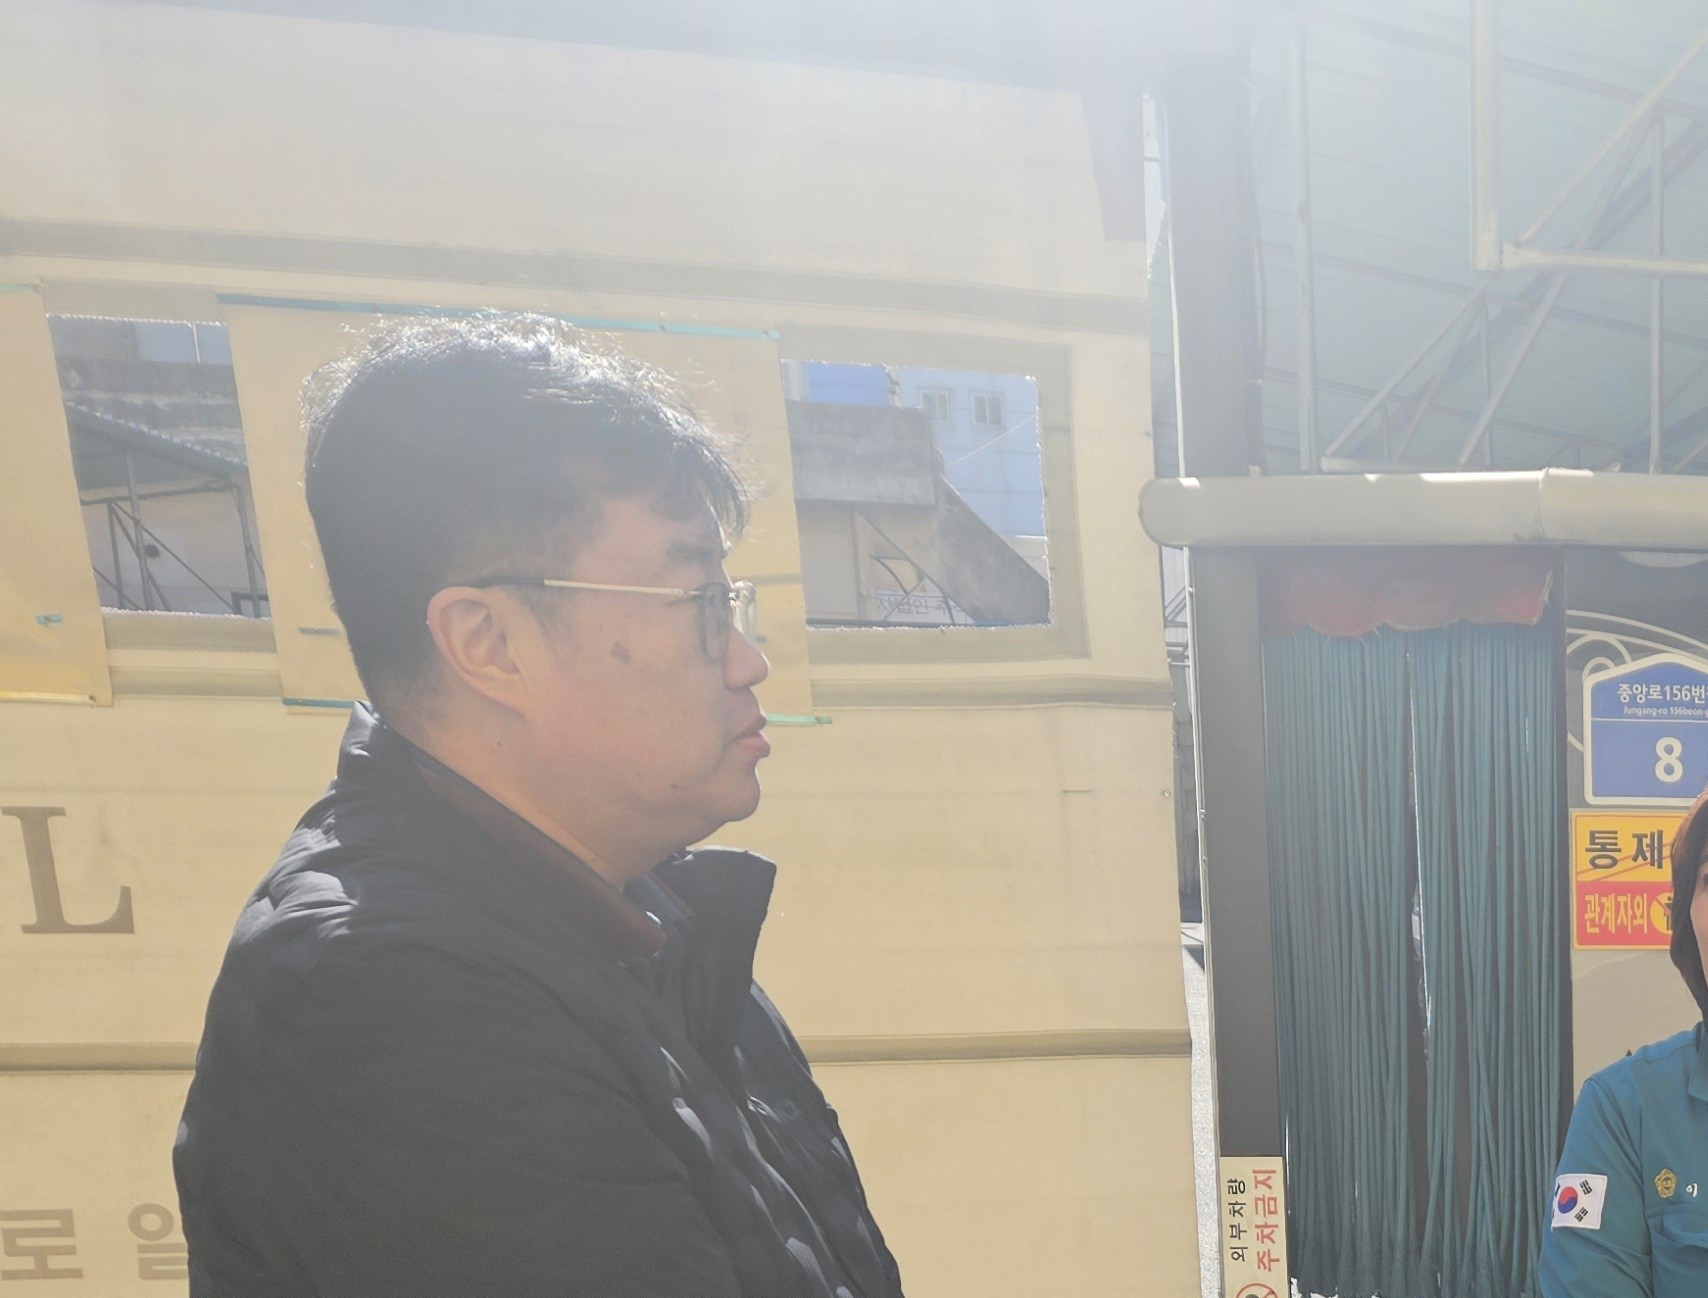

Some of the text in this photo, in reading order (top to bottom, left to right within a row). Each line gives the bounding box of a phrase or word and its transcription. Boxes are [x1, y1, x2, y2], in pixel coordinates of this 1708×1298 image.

[1623, 706, 1668, 717] Jungang-ro
[1654, 736, 1684, 783] 8
[0, 805, 136, 935] L
[1584, 829, 1664, 870] 통제
[1584, 892, 1648, 934] 관계자외
[1227, 1178, 1249, 1262] 외부차량
[1252, 1169, 1281, 1273] 주차금지
